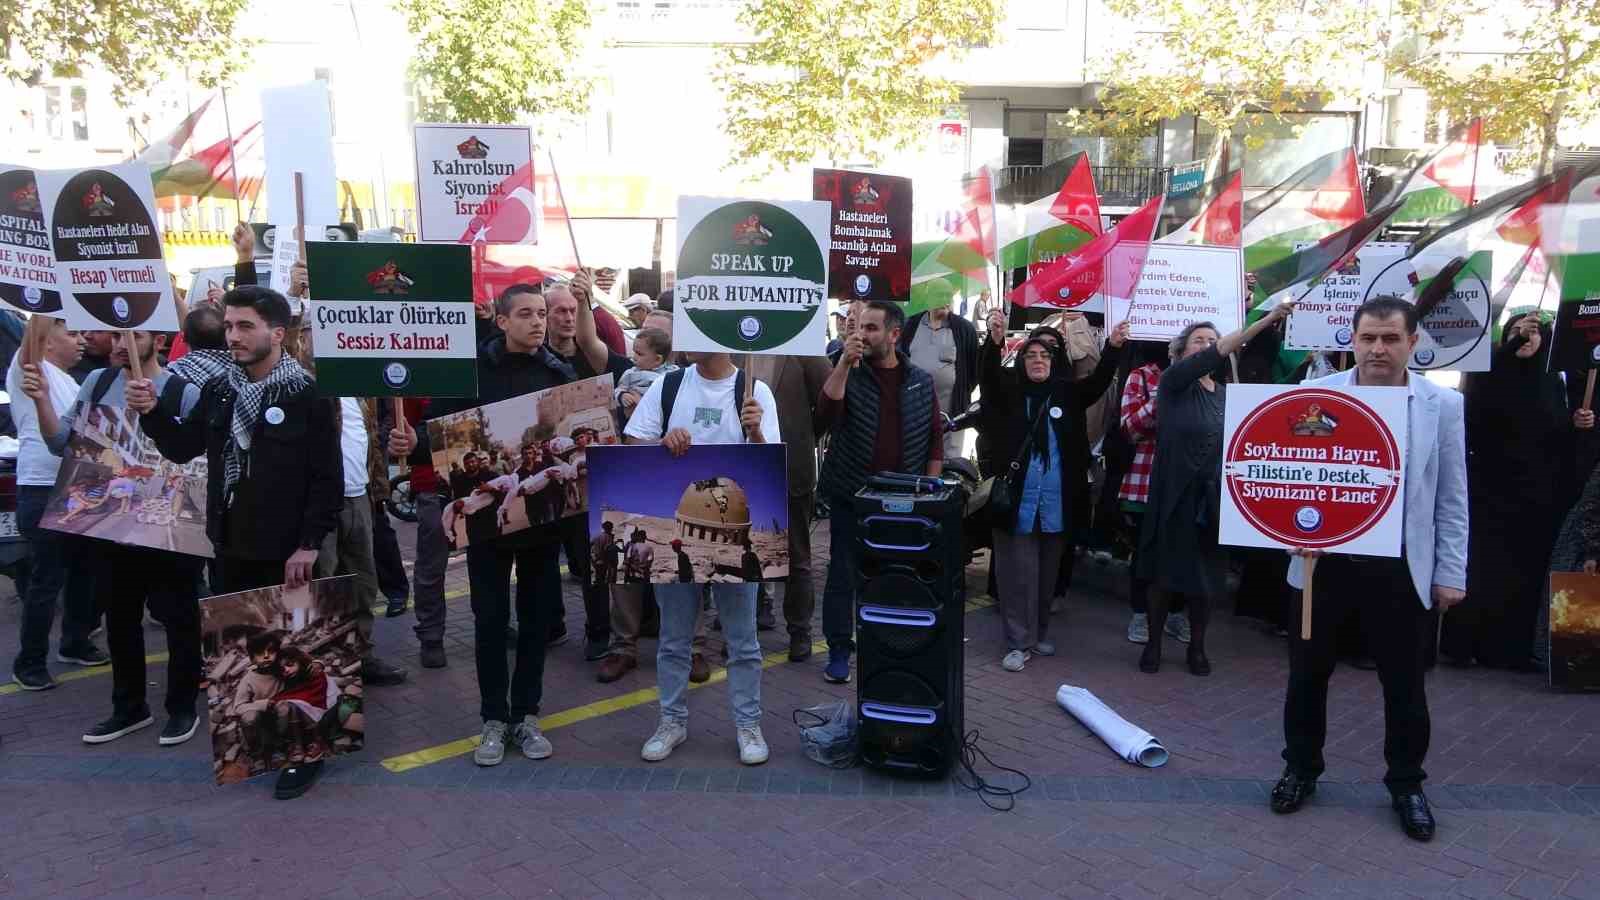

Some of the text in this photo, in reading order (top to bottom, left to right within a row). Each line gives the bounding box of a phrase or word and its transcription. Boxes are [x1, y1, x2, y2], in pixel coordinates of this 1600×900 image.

[432, 160, 515, 175] Kahrolsun
[445, 180, 506, 199] Siyonist
[839, 210, 888, 224] Hastaneleri
[57, 223, 150, 238] Hastaneleri Hedef Alan
[834, 225, 892, 239] Bombalamak
[77, 238, 138, 259] Siyonist İsrail
[870, 242, 897, 255] Açılan
[711, 254, 794, 272] SPEAK UP
[845, 255, 880, 269] Savaştır
[70, 265, 156, 288] Hesap Vermeli
[1168, 273, 1205, 284] Edene,
[687, 284, 815, 304] FOR HUMANITY
[1135, 287, 1210, 301] estek Verene,
[1298, 301, 1332, 314] Dünya
[317, 303, 467, 330] Çocuklar Ölürken
[1130, 316, 1148, 325] Bin
[1150, 317, 1181, 327] Lanet
[336, 332, 450, 351] Sessiz Kalma!
[1243, 442, 1381, 465] Soykırıma Hayır,
[1247, 464, 1376, 487] Filistin'e Destek,
[1242, 482, 1378, 505] Siyonizm'e Lanet
